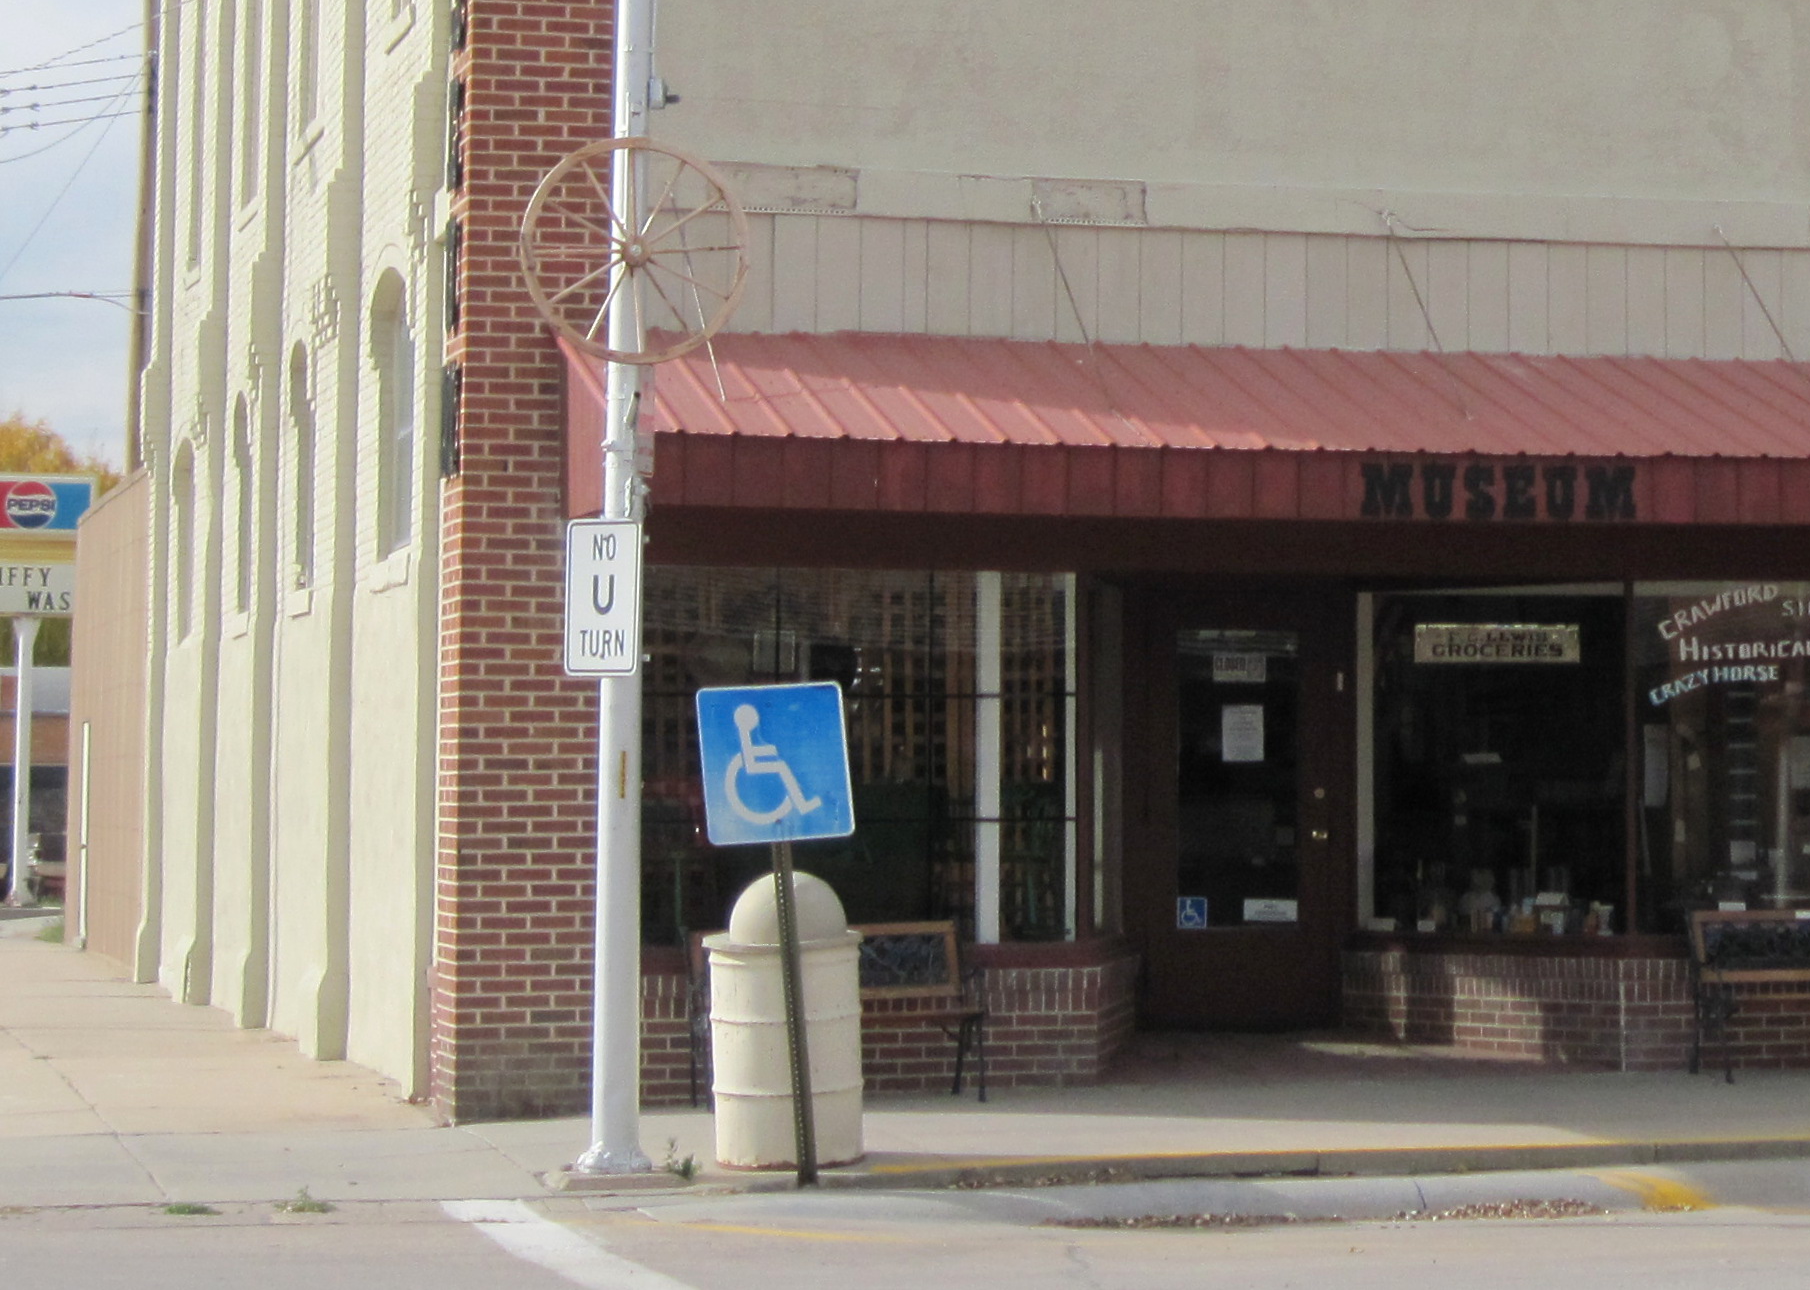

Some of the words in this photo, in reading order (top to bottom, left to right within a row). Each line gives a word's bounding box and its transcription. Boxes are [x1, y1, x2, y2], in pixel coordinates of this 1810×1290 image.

[7, 498, 56, 512] PEPSI
[1360, 463, 1636, 520] MUSEUM
[592, 533, 617, 561] NO
[27, 591, 71, 611] WAS
[592, 574, 615, 615] U
[1657, 584, 1779, 641] CRAWFORD
[579, 628, 626, 658] TURN
[1431, 643, 1563, 657] GROCERIES
